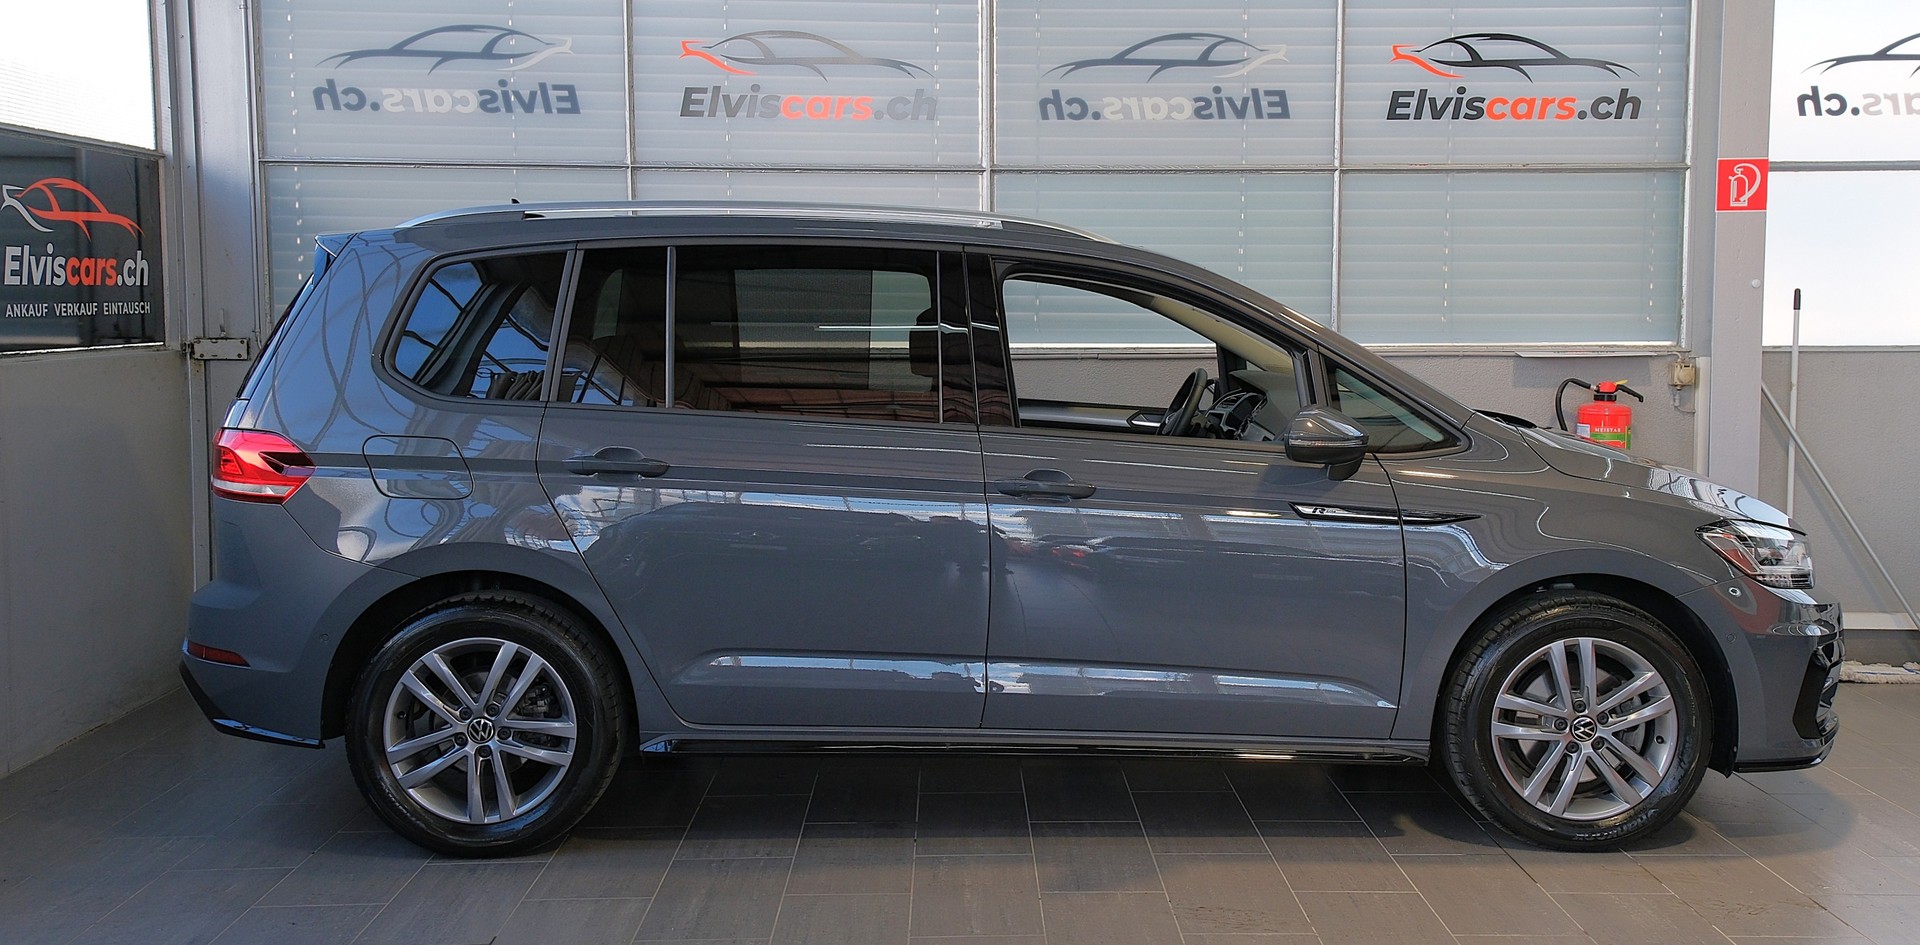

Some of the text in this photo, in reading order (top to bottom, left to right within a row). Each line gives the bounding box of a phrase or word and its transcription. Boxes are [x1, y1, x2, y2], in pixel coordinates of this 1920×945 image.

[679, 83, 938, 121] Elviscars.ch
[1386, 86, 1642, 121] Elviscars.ch
[4, 242, 149, 287] Elviscars.ch
[5, 301, 151, 318] ANKAUF VERKAUF EINTAUSCH
